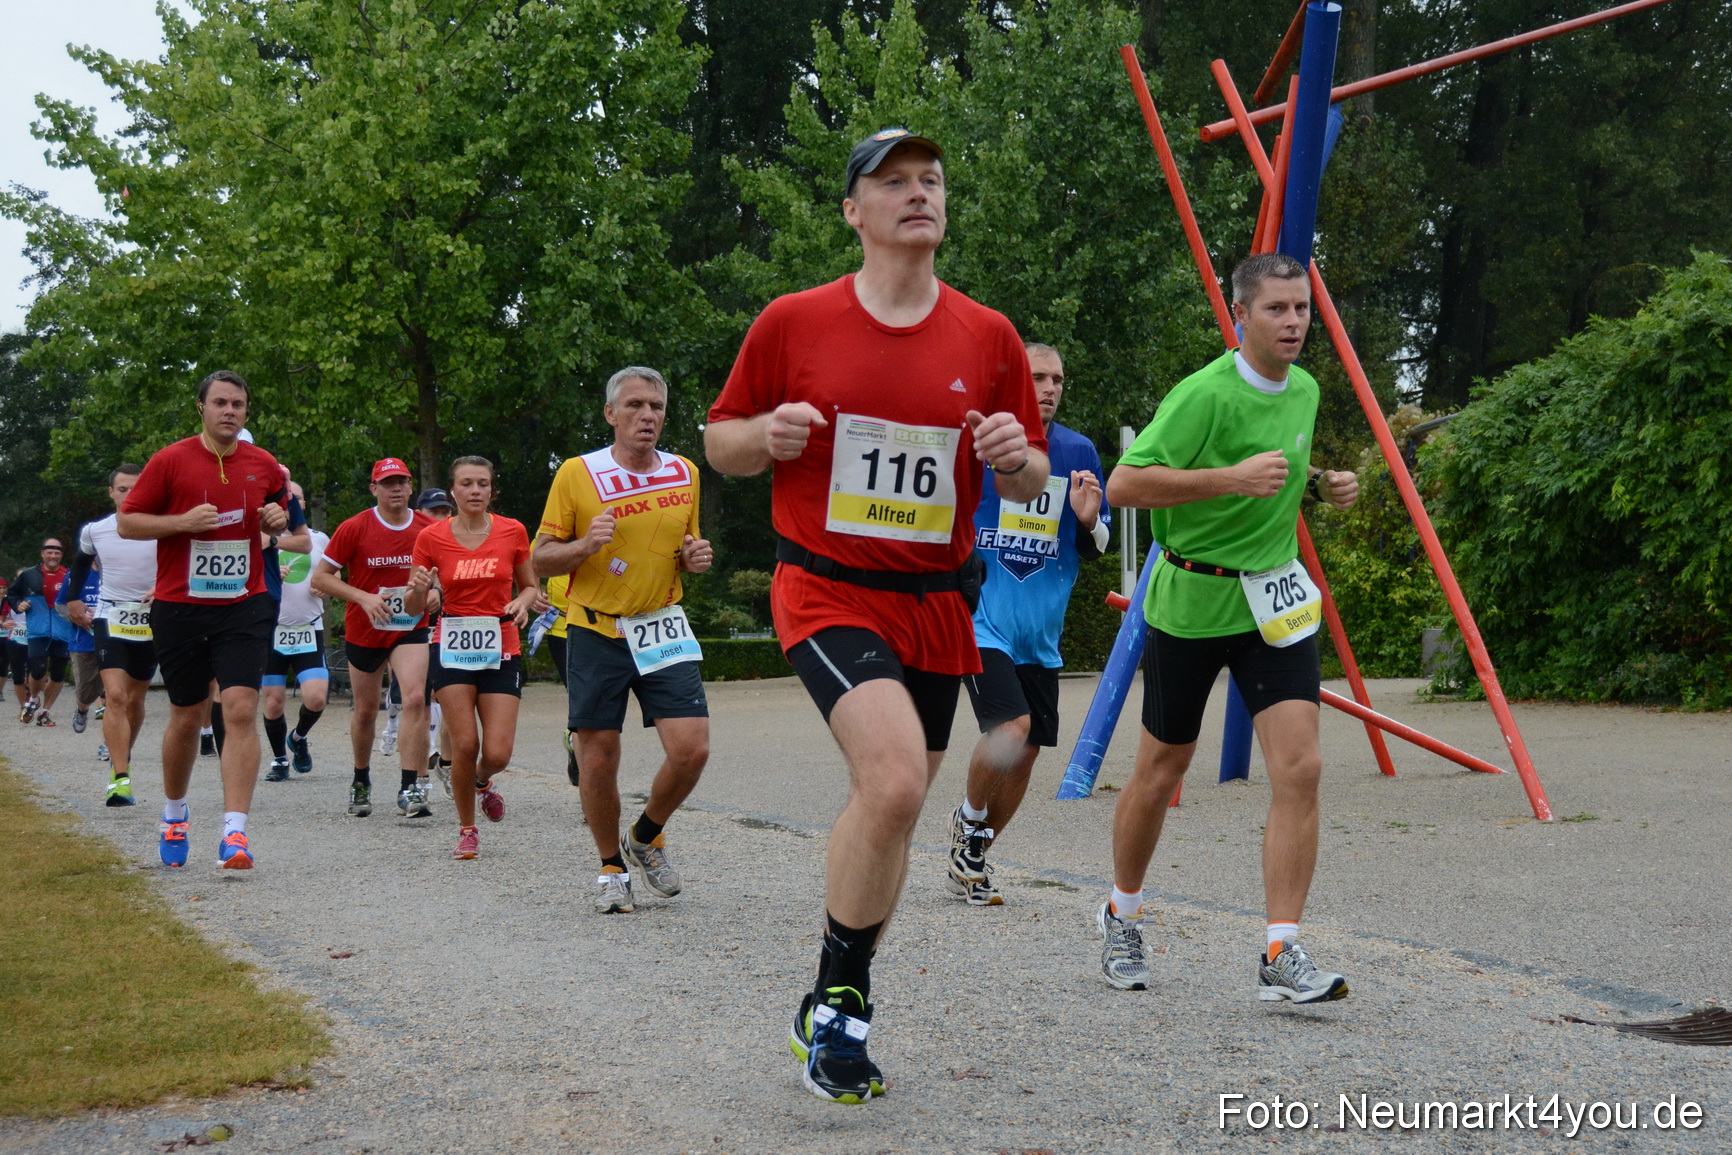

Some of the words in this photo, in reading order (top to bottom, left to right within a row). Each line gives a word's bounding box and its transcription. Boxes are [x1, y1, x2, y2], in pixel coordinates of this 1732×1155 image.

[846, 428, 887, 440] NeuerMarkt
[894, 427, 948, 446] BOCK
[862, 448, 937, 498] 116
[611, 499, 652, 519] MAX
[866, 503, 916, 525] Alfred
[1019, 518, 1046, 531] Simon
[980, 530, 1059, 557] FIBALON
[195, 555, 247, 576] 2623
[453, 557, 499, 580] NIKE
[206, 581, 237, 590] Markus
[1265, 572, 1307, 613] 205
[391, 617, 414, 625] Rainer
[1285, 610, 1312, 630] Bernd
[120, 627, 147, 635] Andreas
[279, 631, 312, 645] 2570
[447, 630, 496, 650] 2802
[633, 616, 687, 649] 2787
[454, 654, 488, 663] Veronika
[660, 644, 684, 659] Josef
